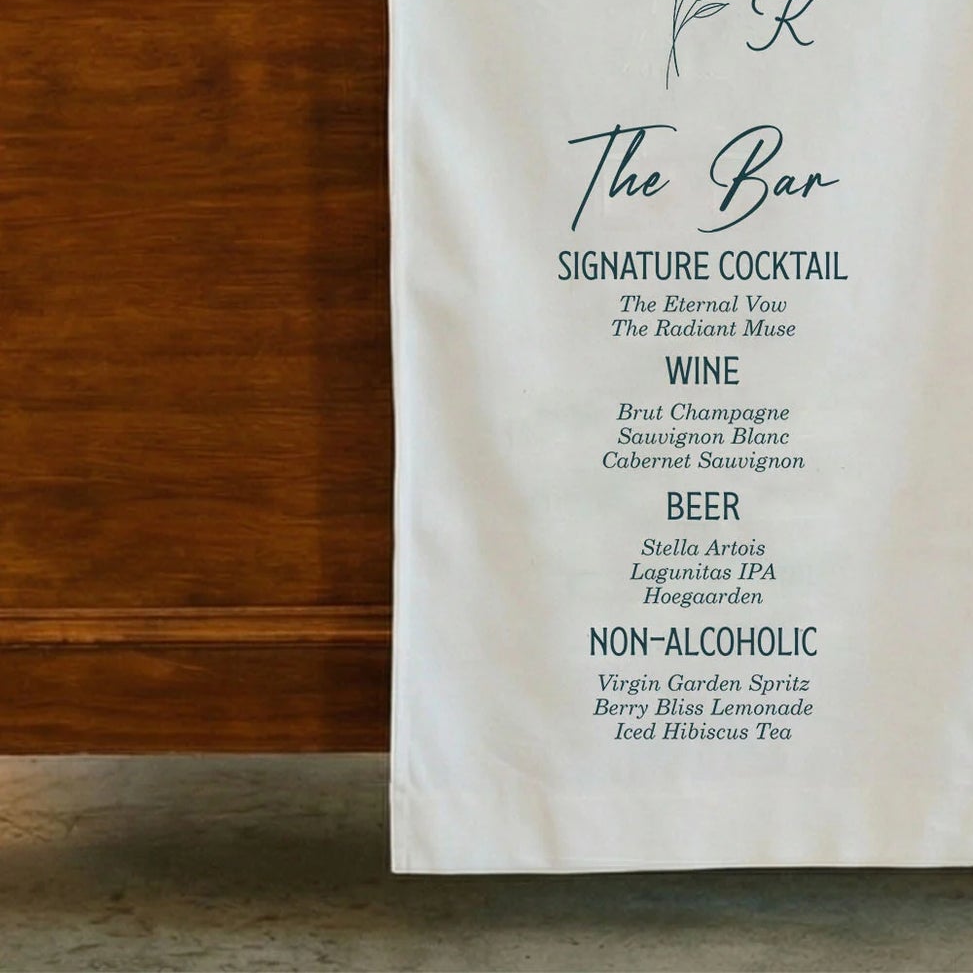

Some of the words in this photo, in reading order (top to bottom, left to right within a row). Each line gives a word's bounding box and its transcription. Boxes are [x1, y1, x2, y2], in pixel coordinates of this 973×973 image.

[567, 123, 678, 232] The
[697, 124, 840, 234] Bar
[557, 250, 710, 281] SIGNATURE
[718, 250, 849, 281] COCKTAIL
[619, 294, 657, 313] The
[662, 294, 739, 313] Eternal
[745, 295, 787, 313] Vow
[611, 318, 649, 337] The
[653, 318, 737, 337] Radiant
[741, 318, 796, 337] Muse
[664, 355, 740, 386] WINE
[616, 402, 664, 421] Brut
[670, 402, 790, 425] Champagne
[617, 426, 725, 449] Sauvignon
[730, 426, 790, 445] Blanc
[602, 450, 691, 469] Cabernet
[697, 450, 806, 473] Sauvignon
[667, 491, 741, 521] BEER
[640, 538, 700, 557] Stella
[703, 538, 766, 557] Artois
[629, 562, 732, 585] Lagunitas
[737, 562, 777, 581] IPA
[642, 586, 764, 609] Hoegaarden
[590, 626, 818, 657] NON-ALCOHOLIC
[598, 673, 662, 696] Virgin
[667, 673, 743, 692] Garden
[748, 673, 810, 696] Spritz
[592, 698, 649, 720] Berry
[654, 697, 704, 716] Bliss
[710, 697, 814, 716] Lemonade
[614, 722, 657, 741] Iced
[661, 722, 749, 741] Hibiscus
[755, 722, 792, 740] Tea
